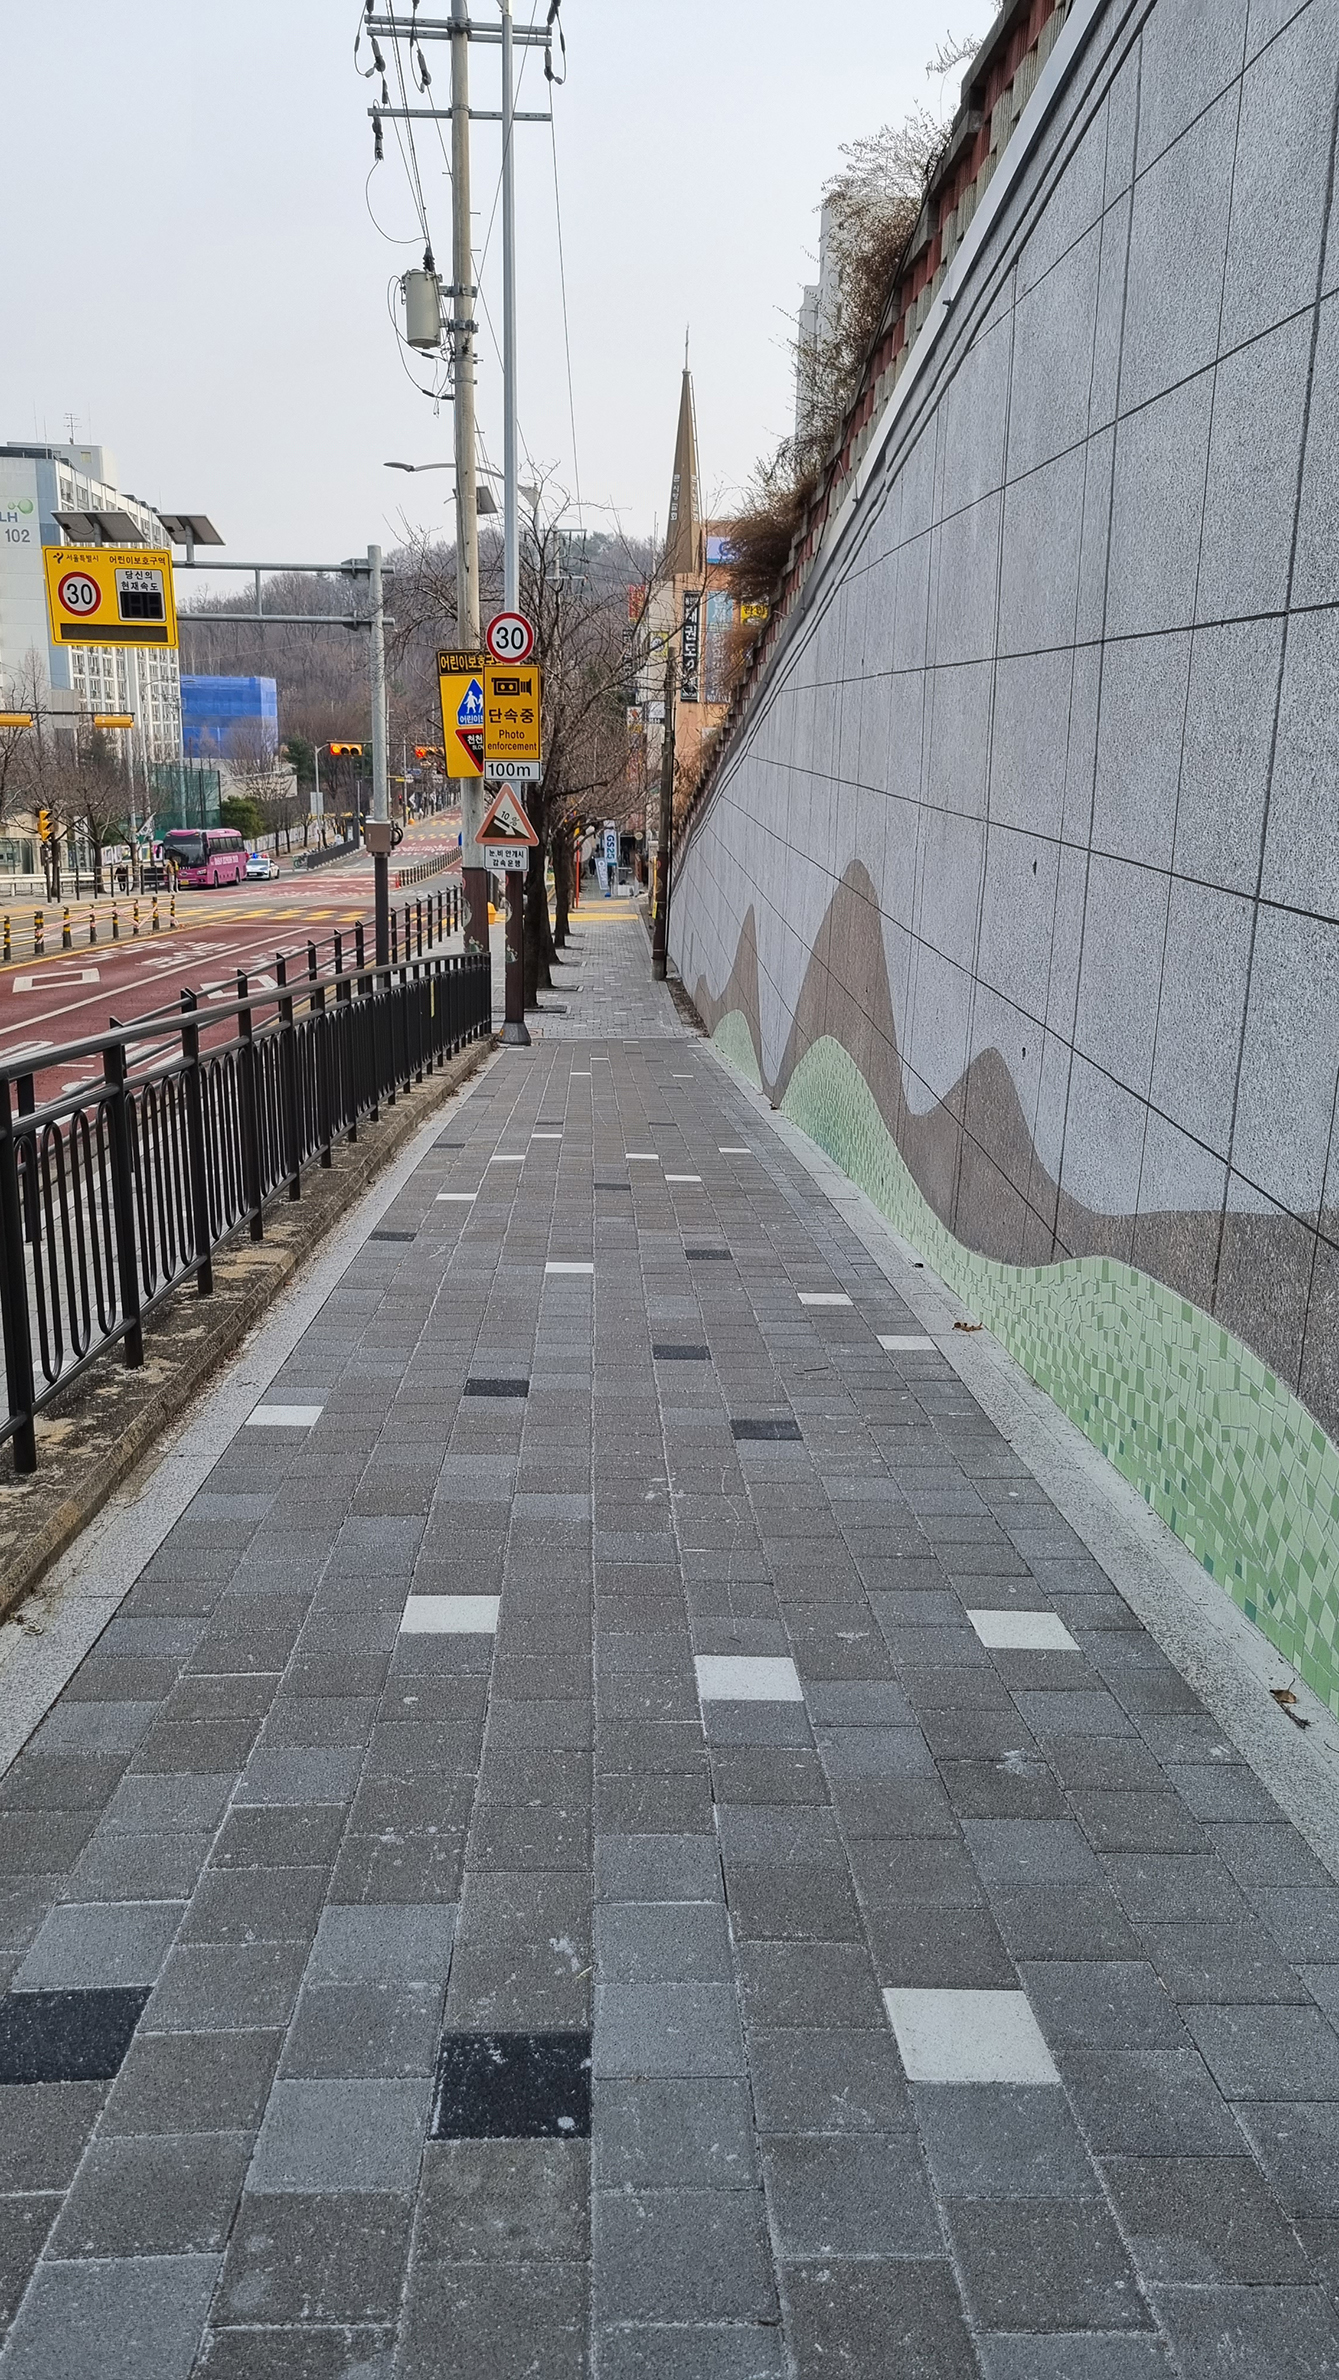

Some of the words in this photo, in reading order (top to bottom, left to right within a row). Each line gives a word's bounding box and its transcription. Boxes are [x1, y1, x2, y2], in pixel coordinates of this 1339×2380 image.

[0, 511, 18, 522] LH
[5, 528, 31, 543] 102
[66, 554, 99, 563] 서울특별시
[109, 555, 166, 566] 어린이보호구역
[125, 570, 153, 580] 당신의
[121, 581, 159, 591] 현재속도
[67, 583, 93, 605] 30
[495, 627, 524, 650] 30
[440, 654, 504, 671] 어린이보호구
[488, 708, 534, 724] 단속중
[467, 734, 484, 745] 천천
[498, 729, 525, 739] Photo
[487, 741, 537, 751] enforcement
[488, 763, 531, 777] 100m
[501, 810, 510, 821] 10
[606, 834, 615, 860] GS25
